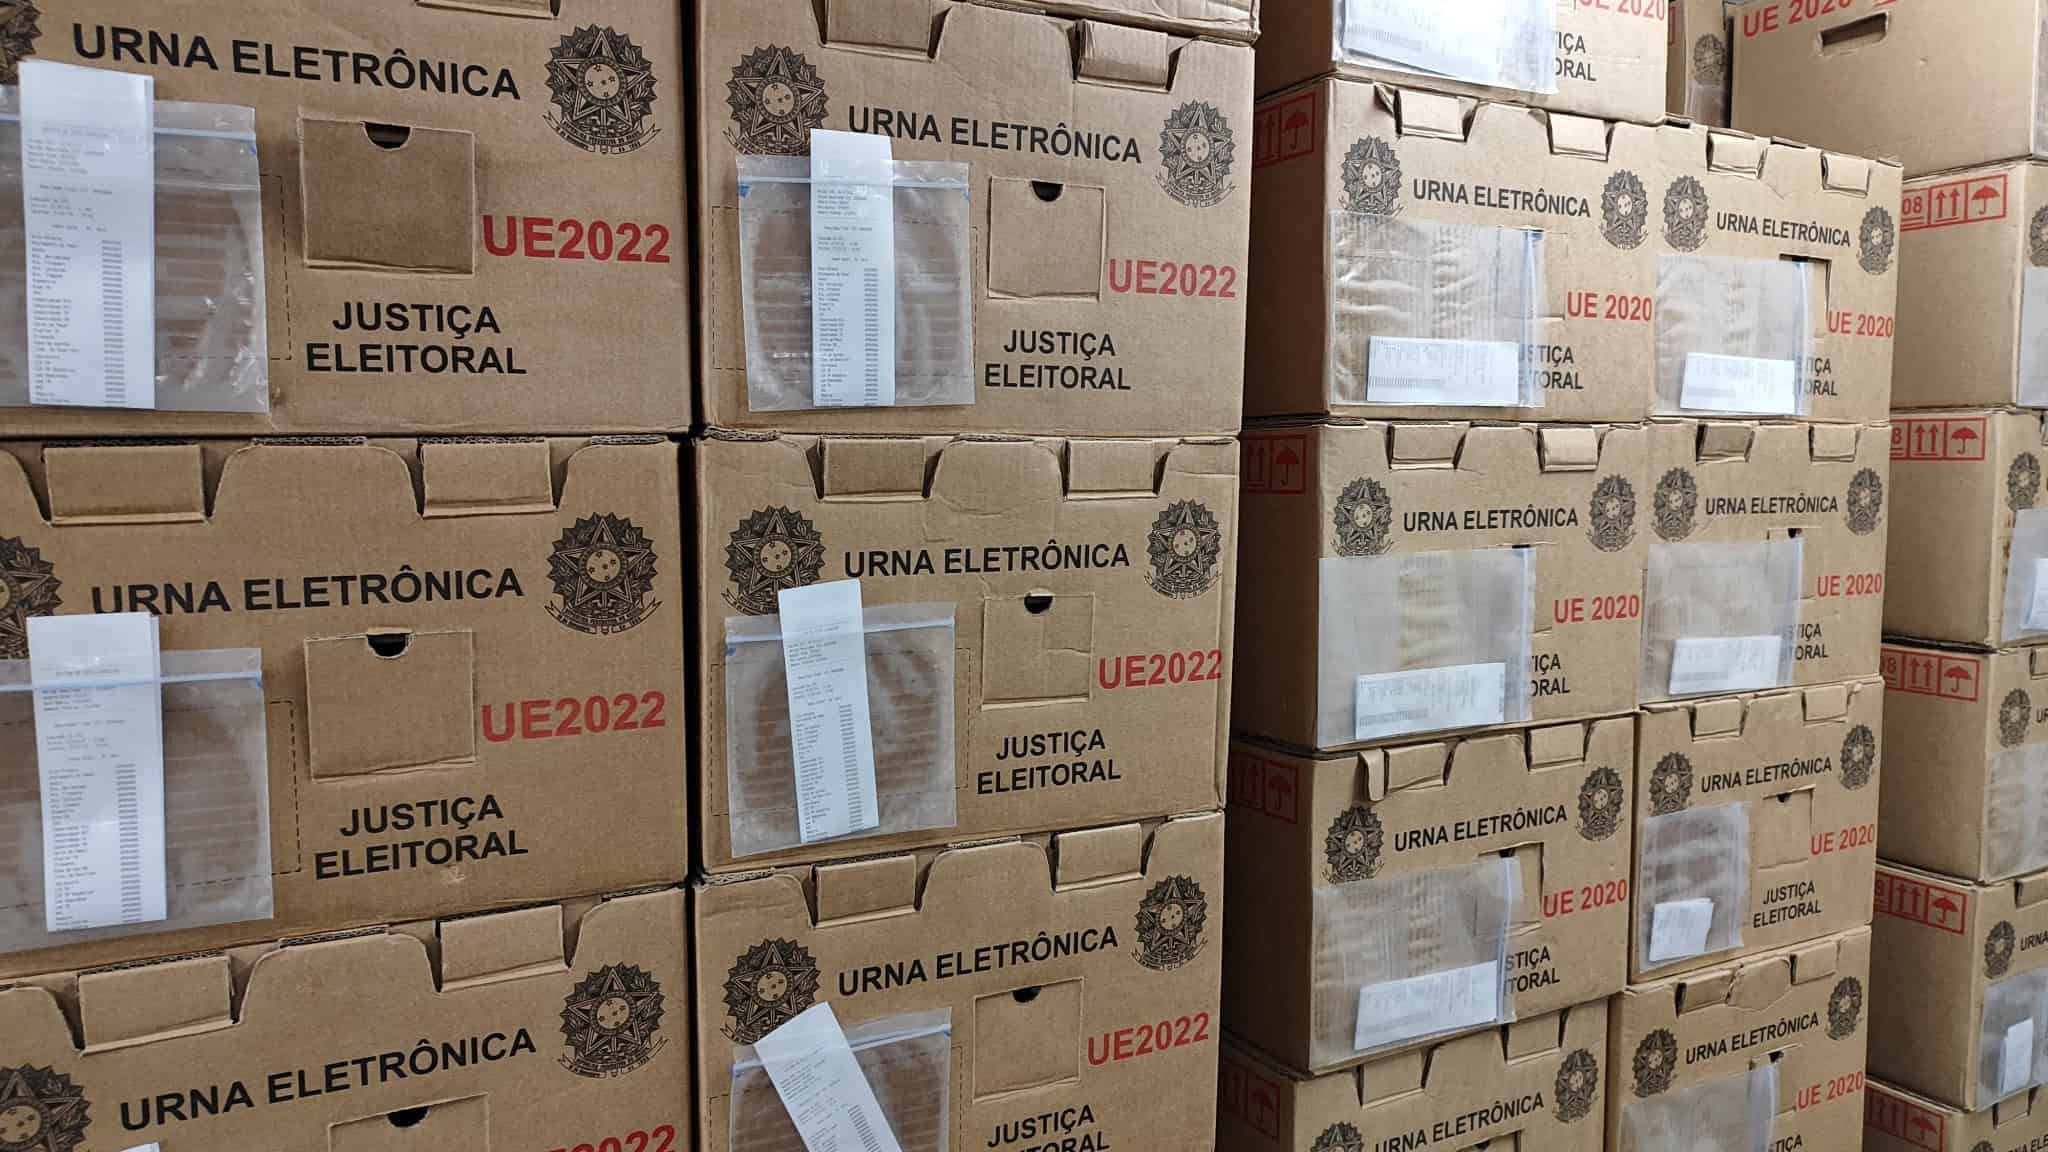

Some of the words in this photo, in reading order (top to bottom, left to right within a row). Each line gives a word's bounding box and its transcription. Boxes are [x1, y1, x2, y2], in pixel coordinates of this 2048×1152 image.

[1743, 5, 1779, 38] UE
[72, 22, 219, 71] URNA
[231, 39, 521, 100] ELETRÔNICA
[848, 104, 942, 143] URNA
[951, 116, 1142, 164] ELETRÔNICA
[1413, 178, 1469, 205] URNA
[1473, 185, 1591, 218] ELETRÔNICA
[483, 215, 671, 264] UE2022
[1716, 211, 1759, 235] URNA
[1763, 215, 1851, 247] ELETRÔNICA
[1107, 258, 1237, 299] UE2022
[332, 301, 501, 340] JUSTIÇA
[1567, 290, 1600, 320] UE
[1606, 295, 1652, 320] 2020
[1828, 310, 1851, 334] UE
[1856, 314, 1893, 337] 2020
[306, 342, 527, 375] ELEITORAL
[1003, 329, 1116, 362] JUSTIÇA
[984, 363, 1131, 391] ELEITORAL
[1403, 511, 1459, 533] URNA
[1463, 503, 1579, 530] ELETRÔNICA
[1705, 497, 1747, 516] URNA
[1750, 492, 1839, 515] ELETRÔNICA
[844, 549, 936, 578] URNA
[944, 538, 1130, 574] ELETRÔNICA
[91, 581, 233, 616] URNA
[243, 564, 524, 611] ELETRÔNICA
[1815, 574, 1841, 599] UE
[1845, 574, 1882, 595] 2020
[1552, 596, 1586, 625] UE
[1589, 592, 1642, 623] 2020
[1097, 648, 1223, 690] UE2022
[481, 688, 667, 745] UE2022
[995, 728, 1106, 761] JUSTIÇA
[977, 758, 1122, 795] ELEITORAL
[1701, 771, 1743, 793] URNA
[1744, 756, 1833, 786] ELETRÔNICA
[340, 795, 503, 837] JUSTIÇA
[1394, 825, 1449, 852] URNA
[1453, 804, 1568, 842] ELETRÔNICA
[315, 828, 529, 881] ELEITORAL
[1808, 831, 1837, 857] UE
[1543, 891, 1573, 918] UE
[1582, 879, 1627, 911] 2020
[1762, 879, 1816, 905] JUSTIÇA
[1752, 899, 1822, 929] ELEITORAL
[838, 959, 928, 997] URNA
[936, 925, 1119, 980] ELETRÔNICA
[1505, 946, 1550, 970] STIÇA
[1087, 1010, 1211, 1067] UE2022
[1685, 1038, 1728, 1065] URNA
[1731, 1011, 1819, 1052] ELETRÔNICA
[120, 1080, 254, 1130] URNA
[267, 1027, 536, 1104] ELETRÔNICA
[1797, 1086, 1822, 1109] UE
[1827, 1071, 1864, 1099] 2020
[988, 1104, 1095, 1148] JUSTIÇA
[1432, 1092, 1544, 1142] ELETRÔNICA
